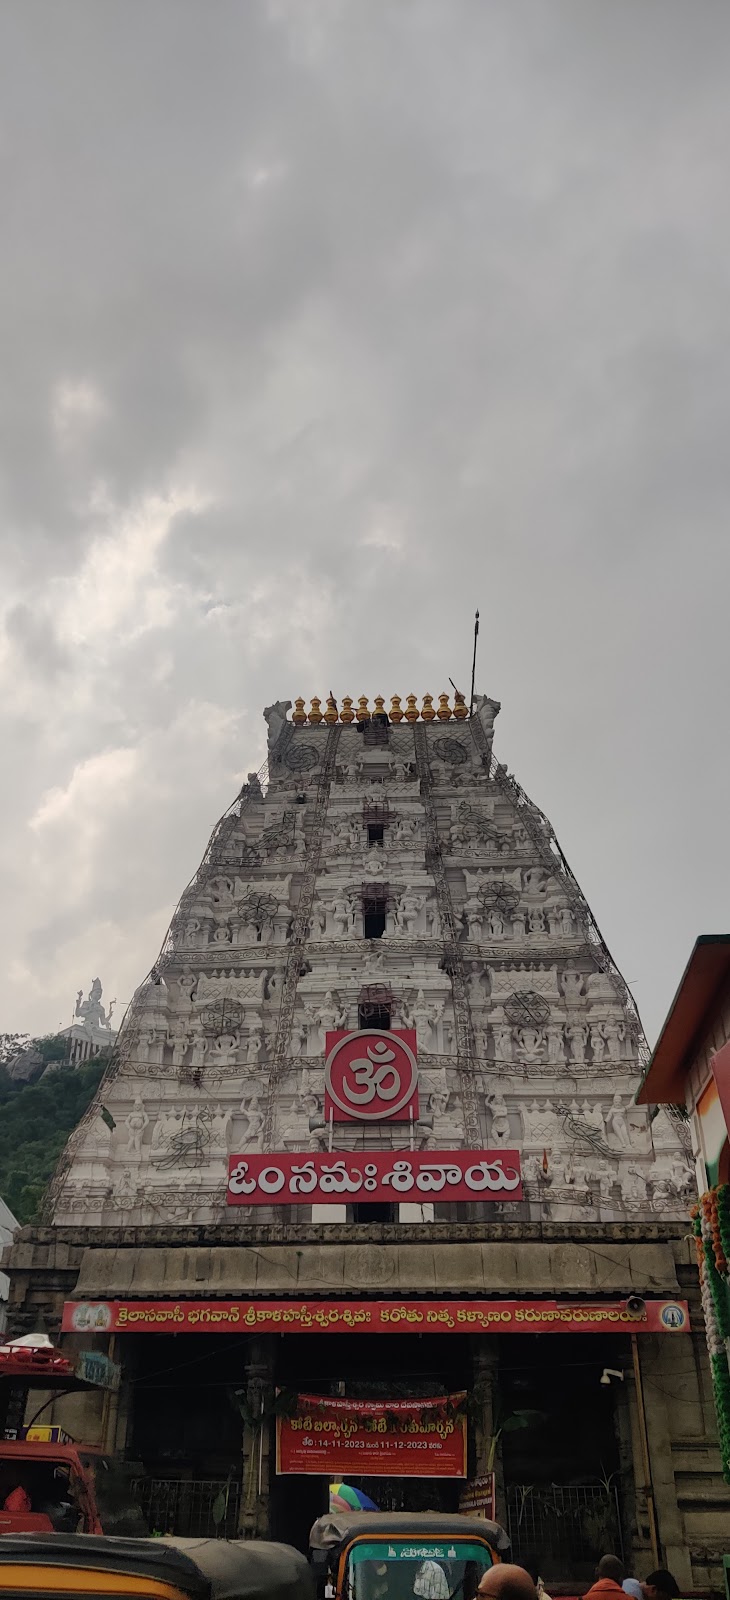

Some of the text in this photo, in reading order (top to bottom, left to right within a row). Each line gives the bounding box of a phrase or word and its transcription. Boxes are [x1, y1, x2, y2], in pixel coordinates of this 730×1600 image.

[115, 1305, 185, 1327] కైలాసవాసీ
[188, 1306, 240, 1324] భగవాన్
[380, 1306, 424, 1323] కరోతు
[426, 1308, 455, 1328] నిత్య
[457, 1308, 512, 1328] కళ్యాణం
[319, 1439, 366, 1449] 14-11-2023
[381, 1441, 428, 1450] 11-12-2023
